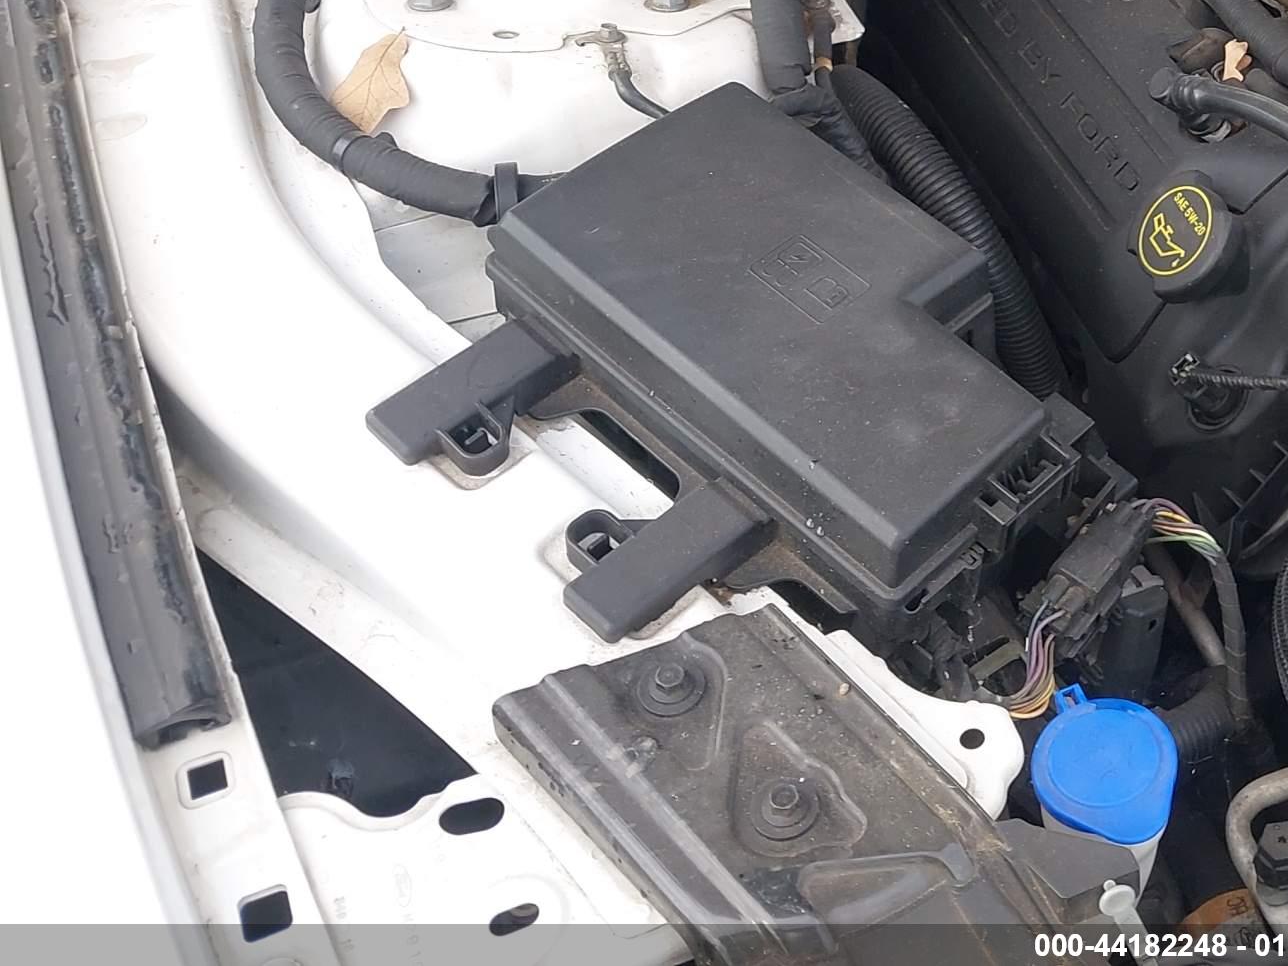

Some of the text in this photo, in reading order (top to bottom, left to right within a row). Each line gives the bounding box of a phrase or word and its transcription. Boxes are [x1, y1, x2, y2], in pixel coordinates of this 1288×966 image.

[1017, 38, 1062, 84] BY
[1059, 90, 1140, 192] FORD
[1173, 192, 1206, 236] SAE 5W-20
